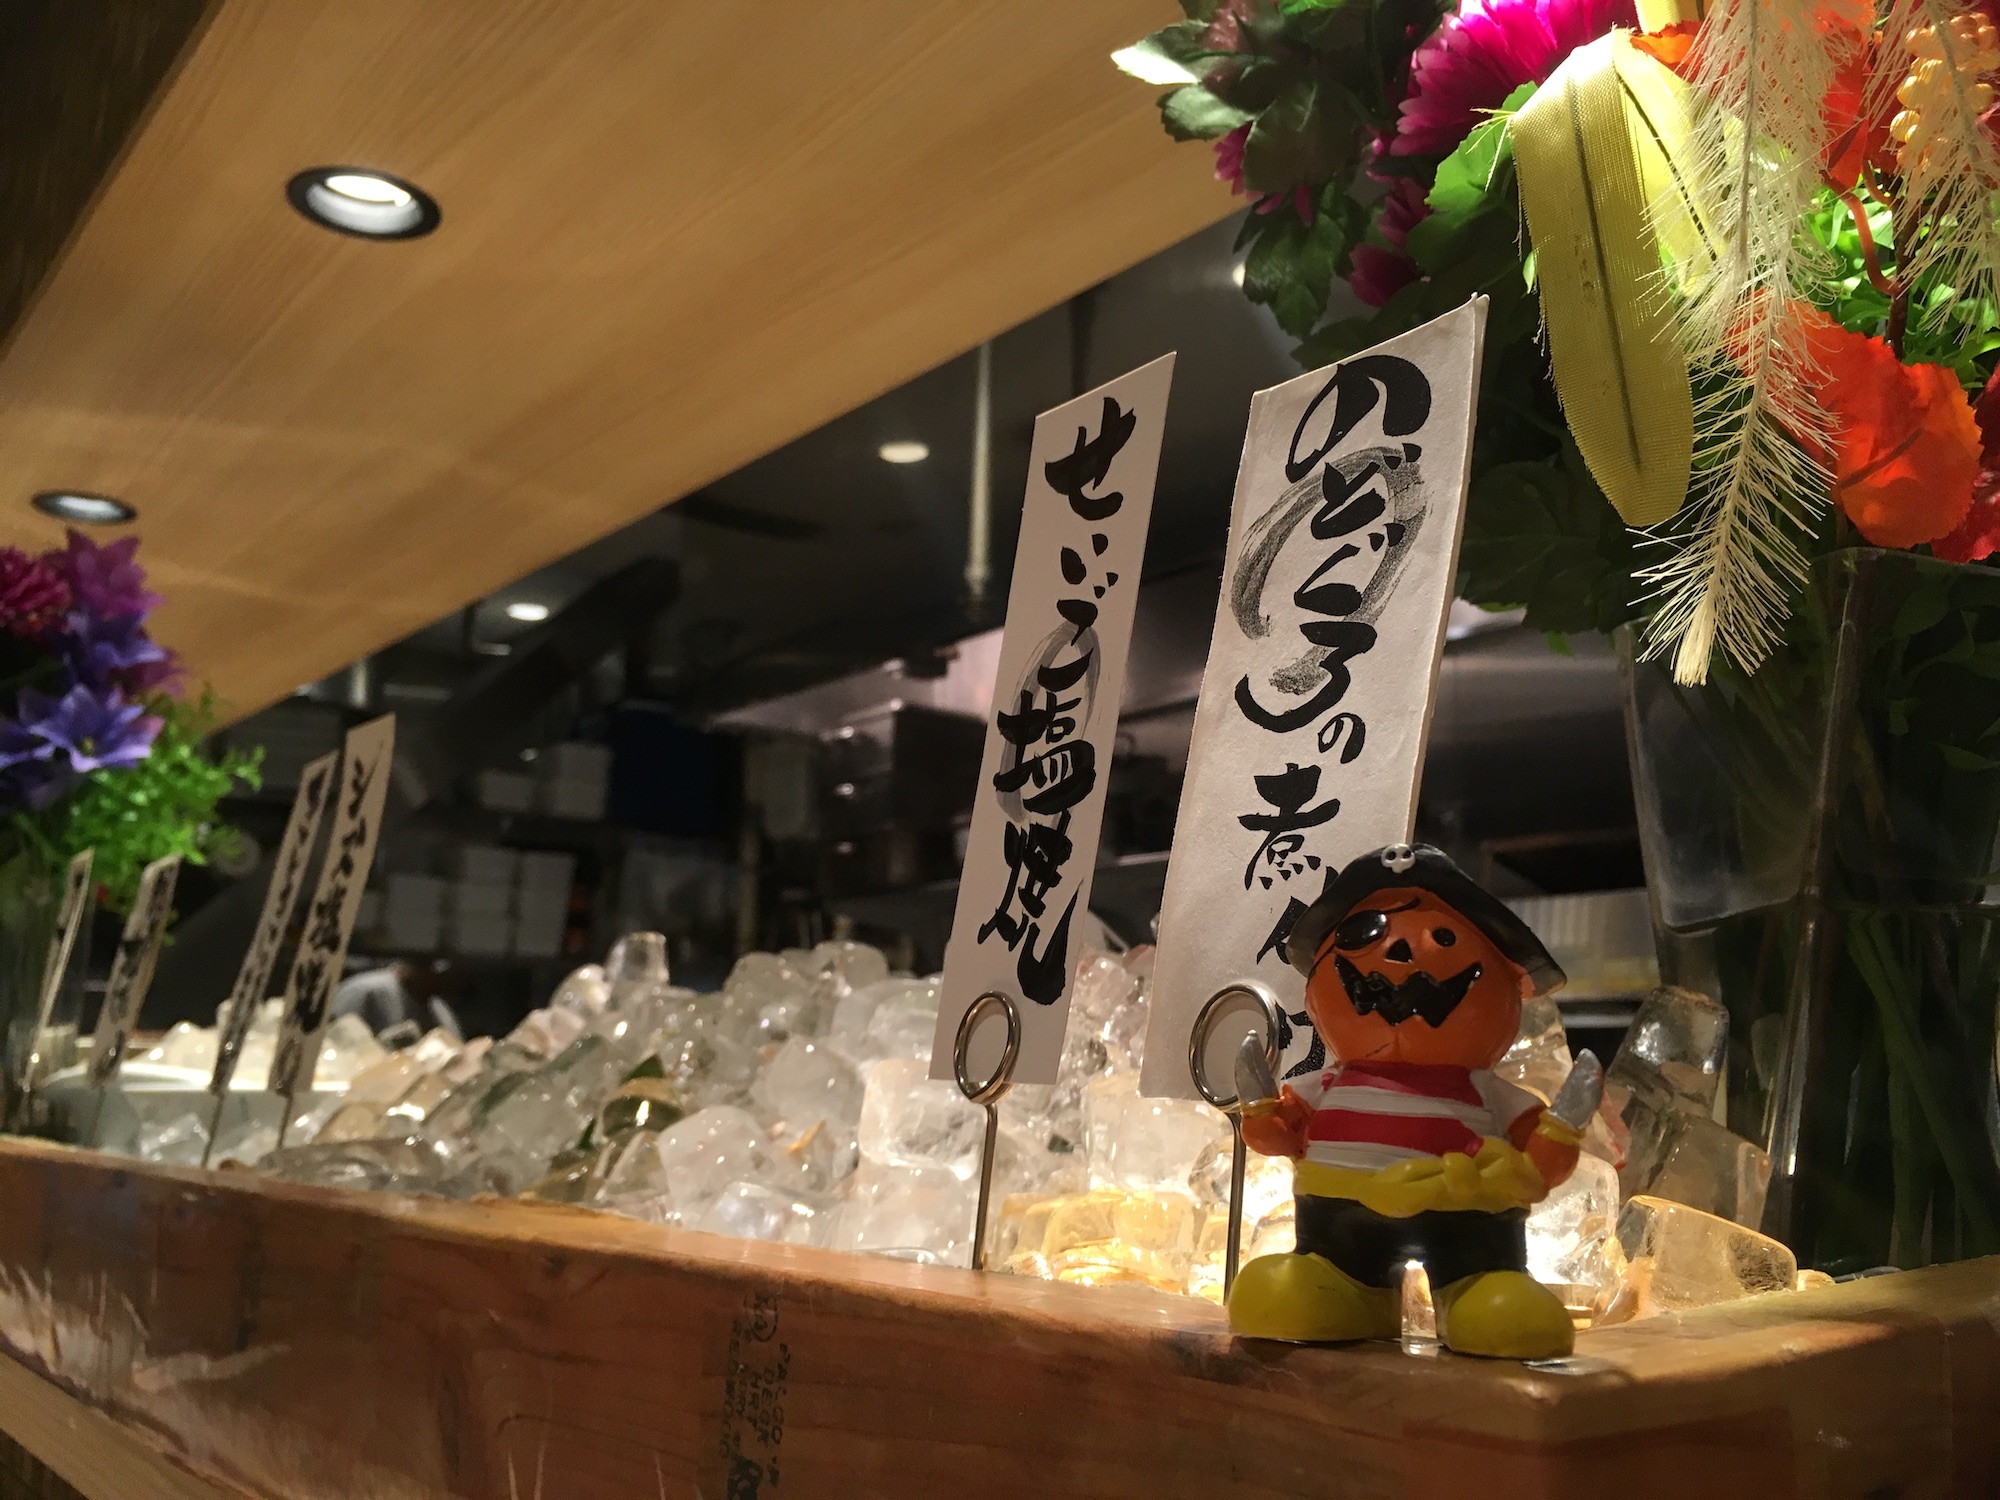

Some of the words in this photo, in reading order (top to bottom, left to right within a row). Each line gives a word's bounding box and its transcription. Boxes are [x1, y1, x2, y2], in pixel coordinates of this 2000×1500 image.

[1235, 355, 1432, 1081] のどぐろの煮
